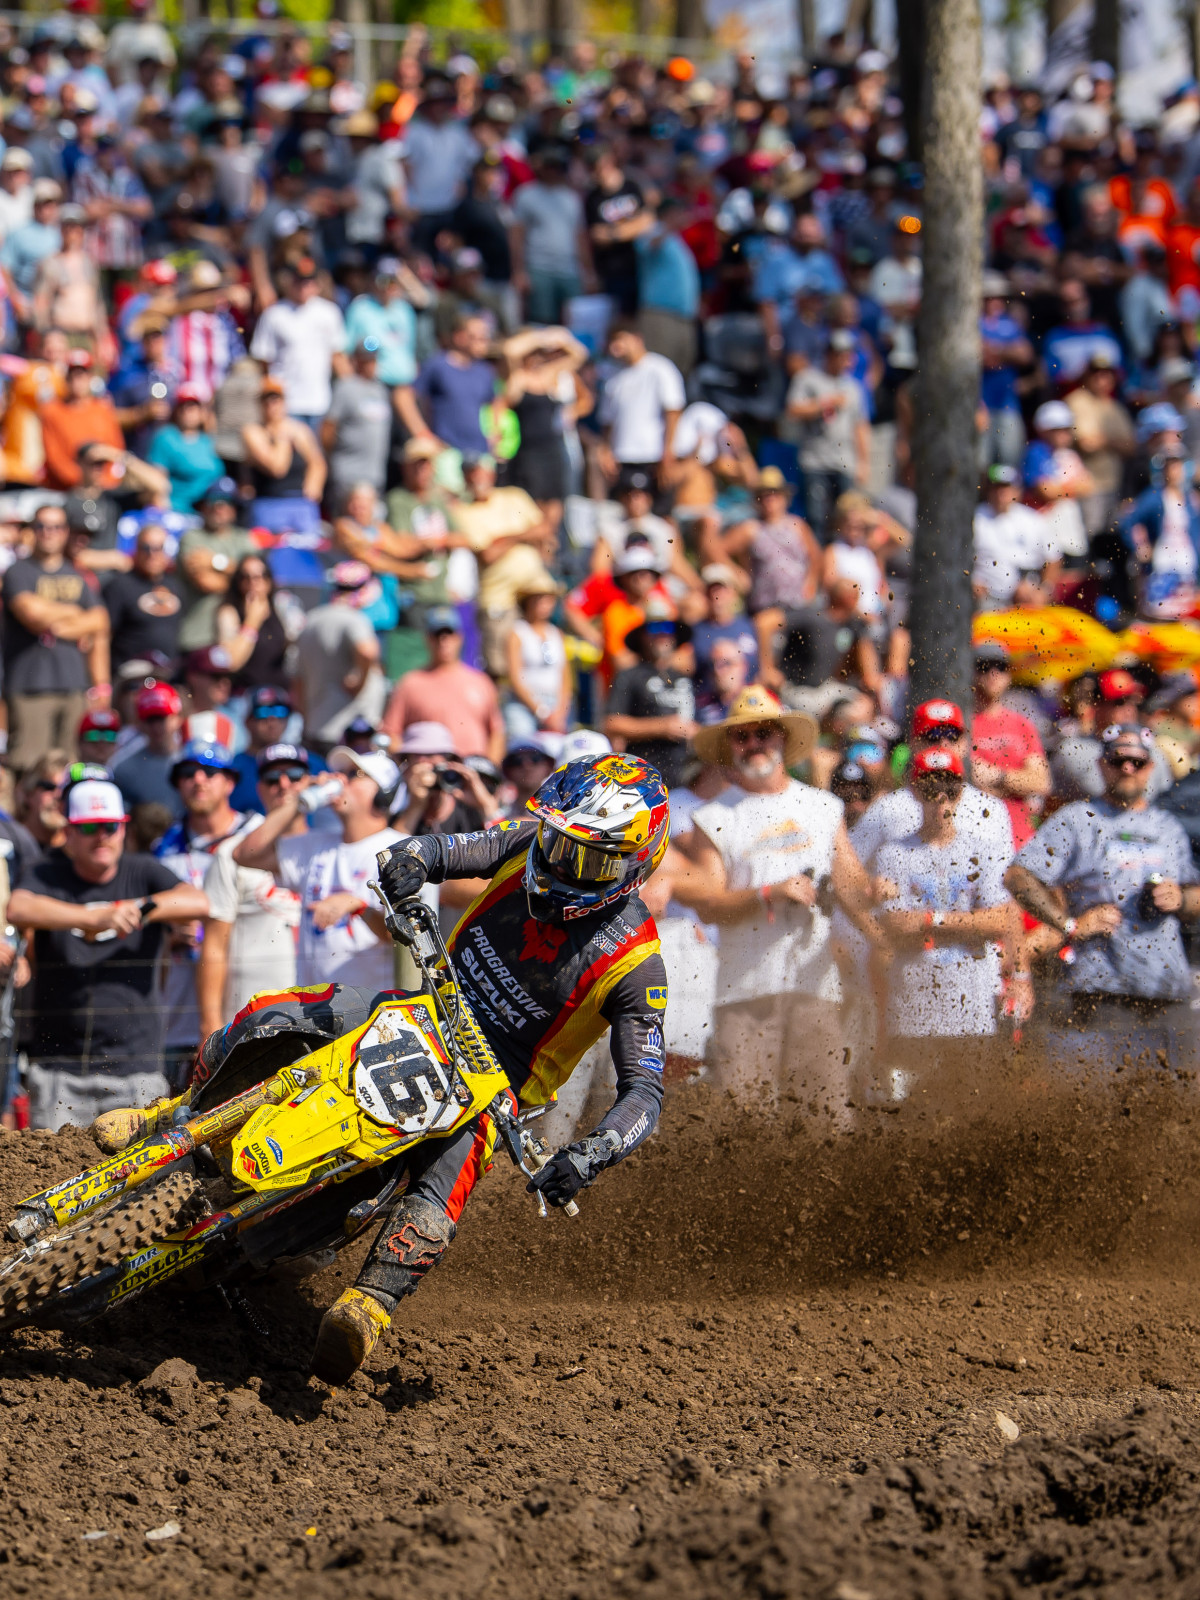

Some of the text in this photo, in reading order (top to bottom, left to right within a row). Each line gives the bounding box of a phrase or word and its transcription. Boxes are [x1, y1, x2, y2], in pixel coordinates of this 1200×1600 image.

[460, 946, 527, 1029] SUZUKI
[469, 925, 551, 1020] PROGRESSIVE
[359, 1028, 448, 1120] 16
[250, 1142, 272, 1175] DIXXON
[67, 1179, 129, 1218] ECSTAR
[109, 1241, 197, 1299] DUNLOP
[128, 1246, 159, 1271] TAR
